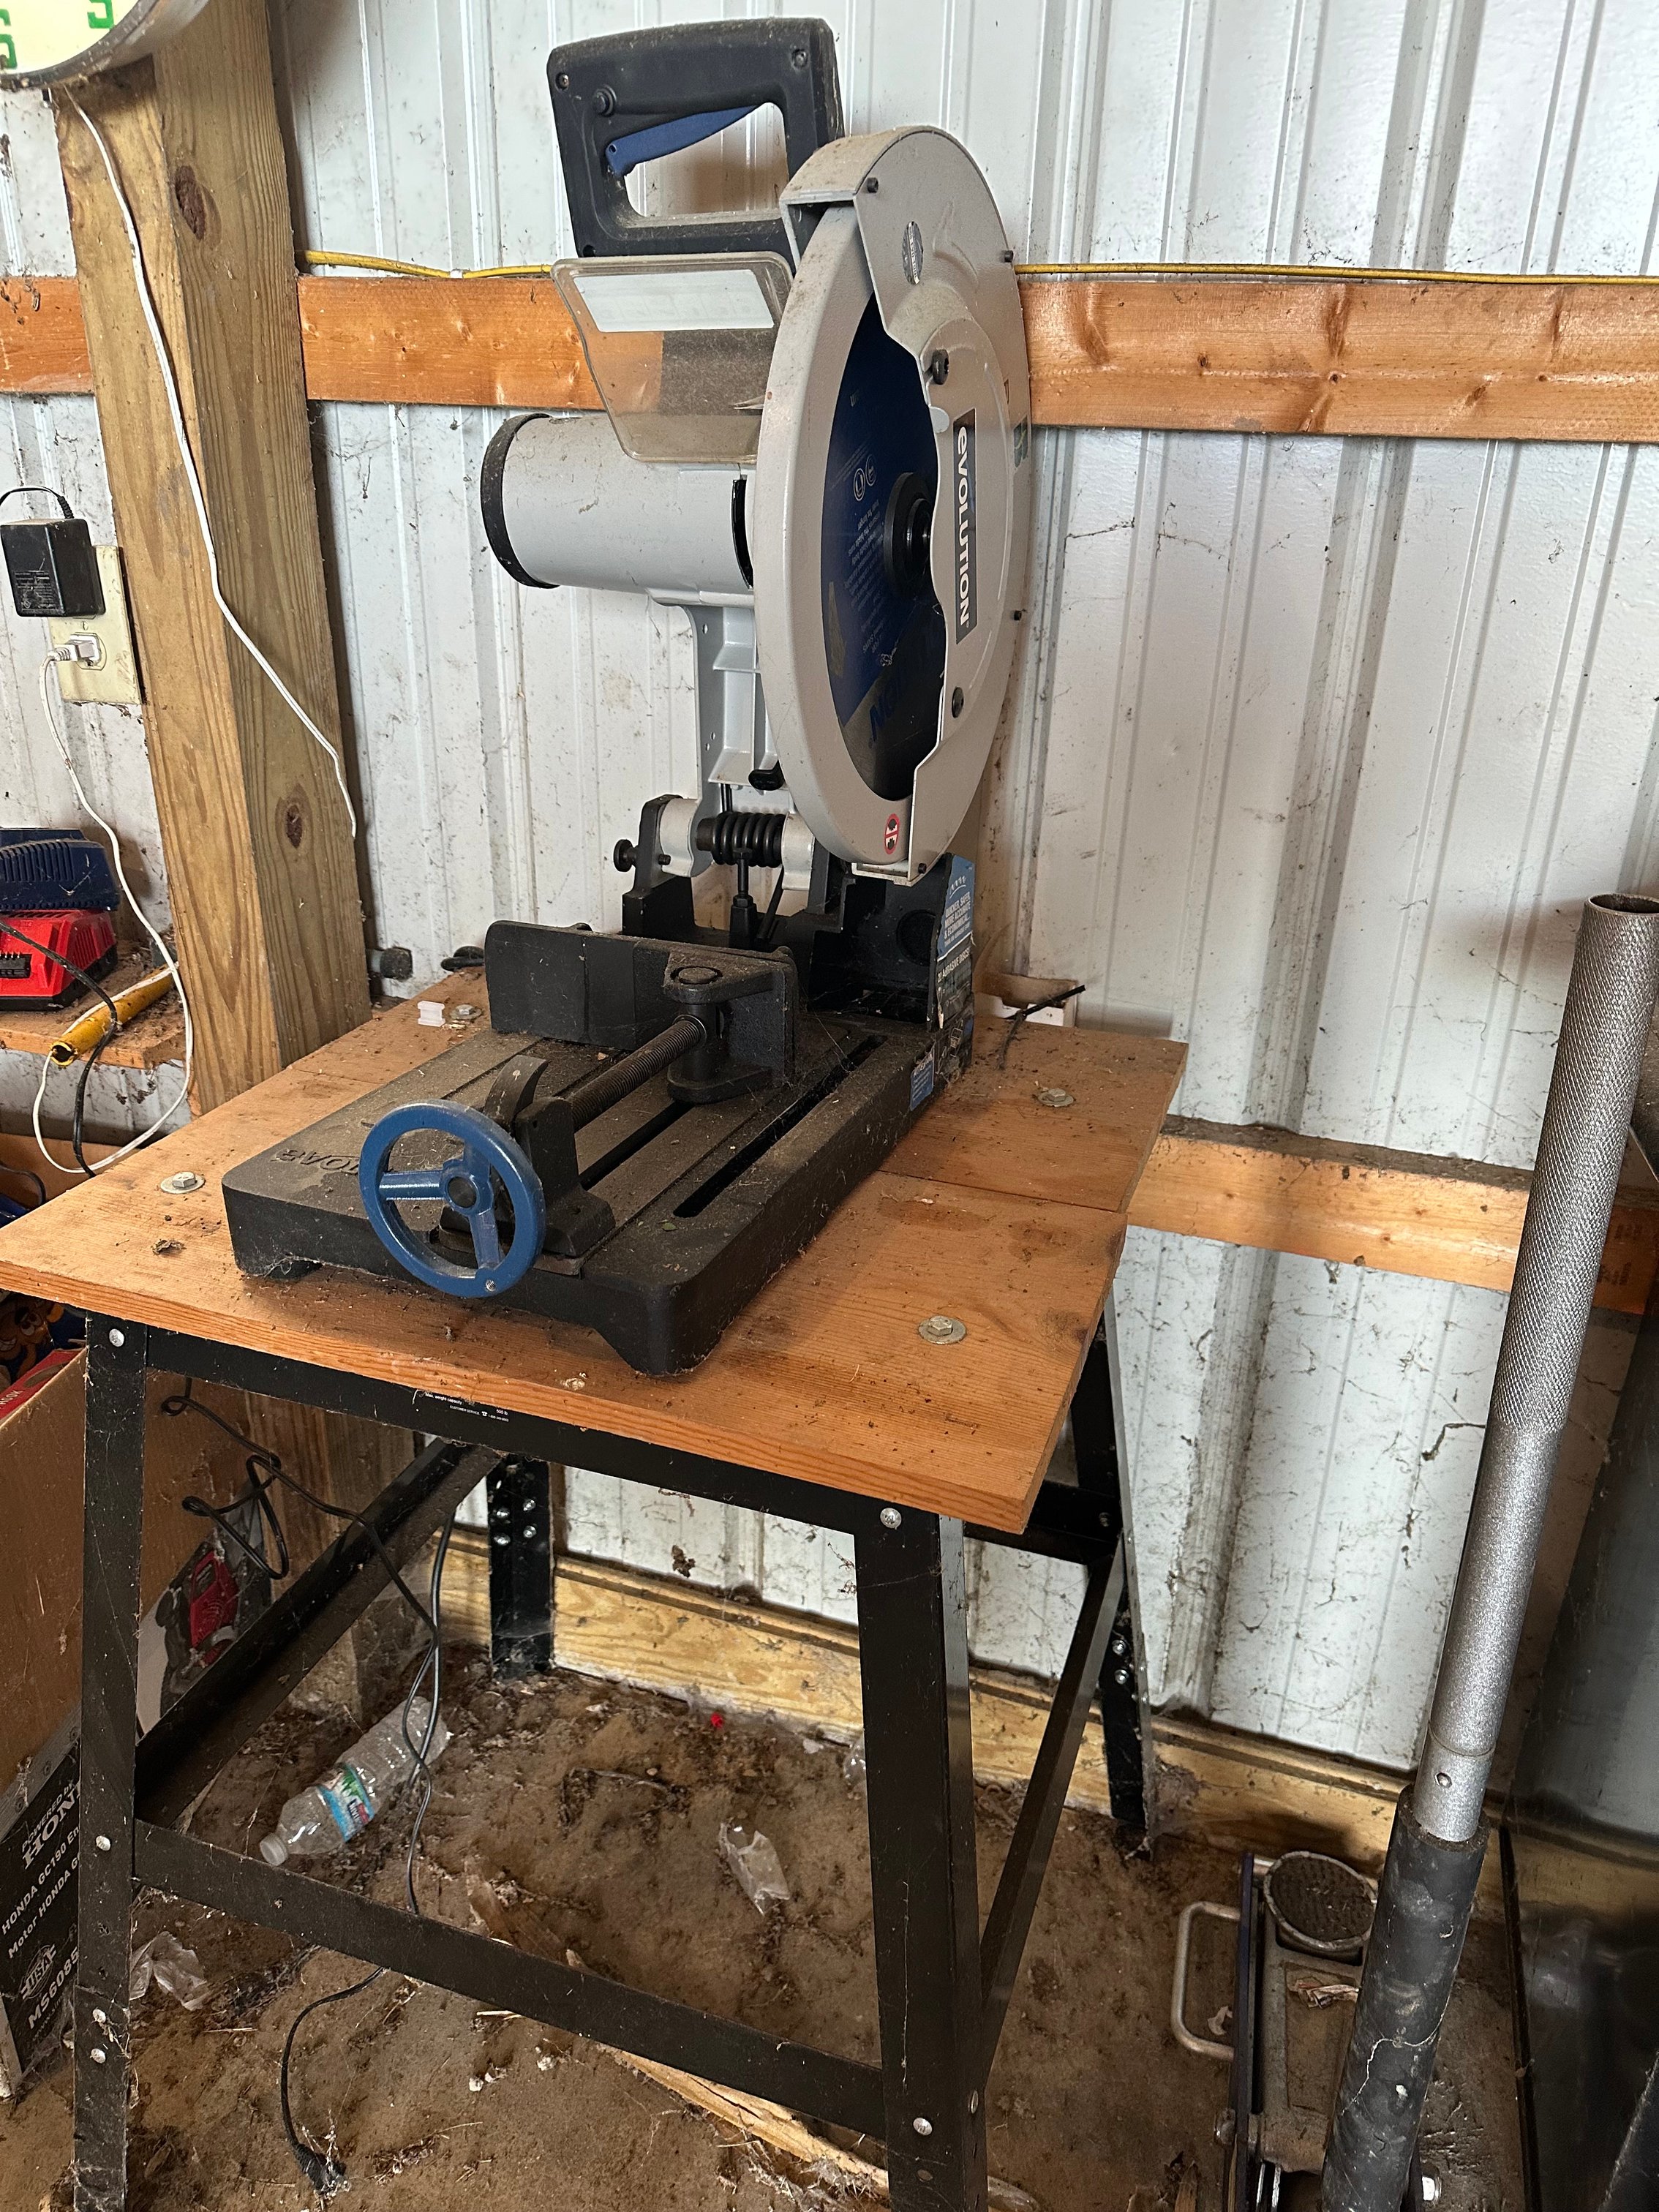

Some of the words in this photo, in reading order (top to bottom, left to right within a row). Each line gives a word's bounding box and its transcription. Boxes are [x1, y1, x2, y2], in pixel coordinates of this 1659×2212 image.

[22, 1794, 63, 1853] POWERED
[2, 1885, 38, 1936] HONDA
[38, 1843, 67, 1885] GC190
[67, 1826, 79, 1844] En
[8, 1915, 38, 1959] Motor
[39, 1870, 72, 1919] HONDA
